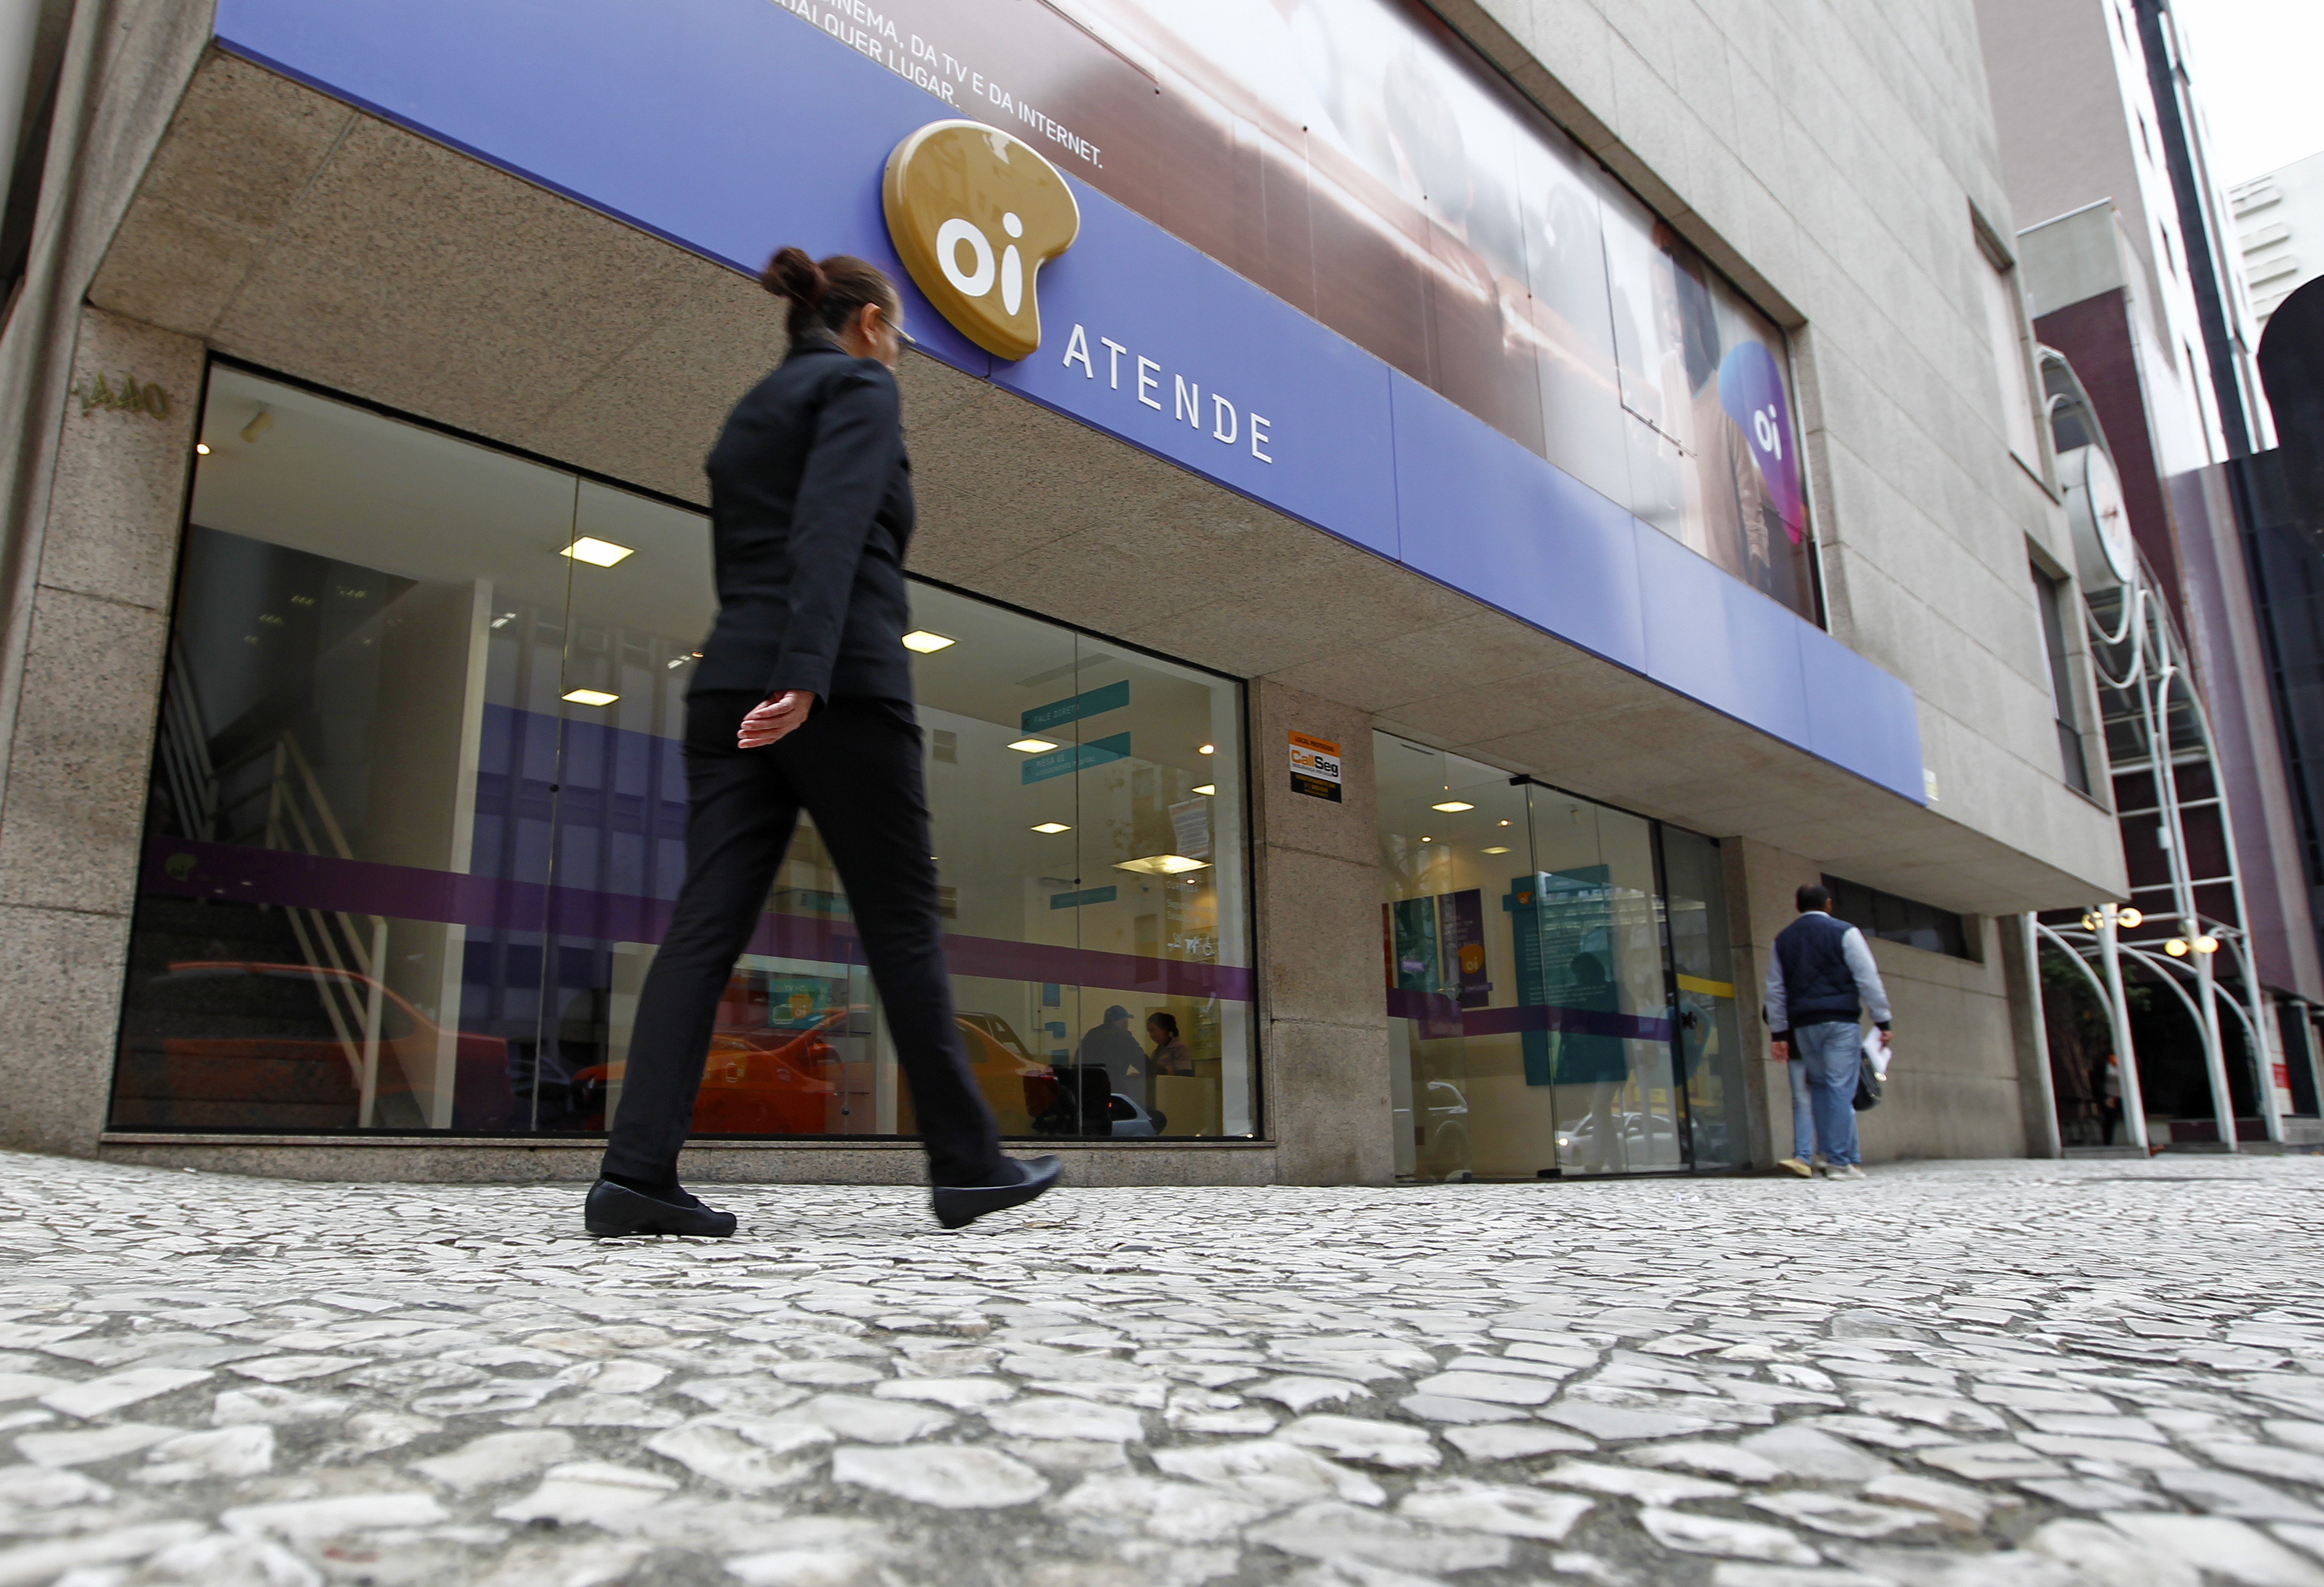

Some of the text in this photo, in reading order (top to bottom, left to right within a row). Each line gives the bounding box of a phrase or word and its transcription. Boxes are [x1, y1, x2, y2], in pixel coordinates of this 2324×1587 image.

[774, 0, 960, 108] ALQUER LUGAR.
[821, 0, 1103, 169] NEMA, DA TV E DA INTERNET.
[936, 212, 1023, 316] oi
[1062, 323, 1273, 464] ATENDE
[1753, 403, 1782, 461] oi
[1291, 749, 1339, 778] CallSeg
[1466, 957, 1479, 971] oi
